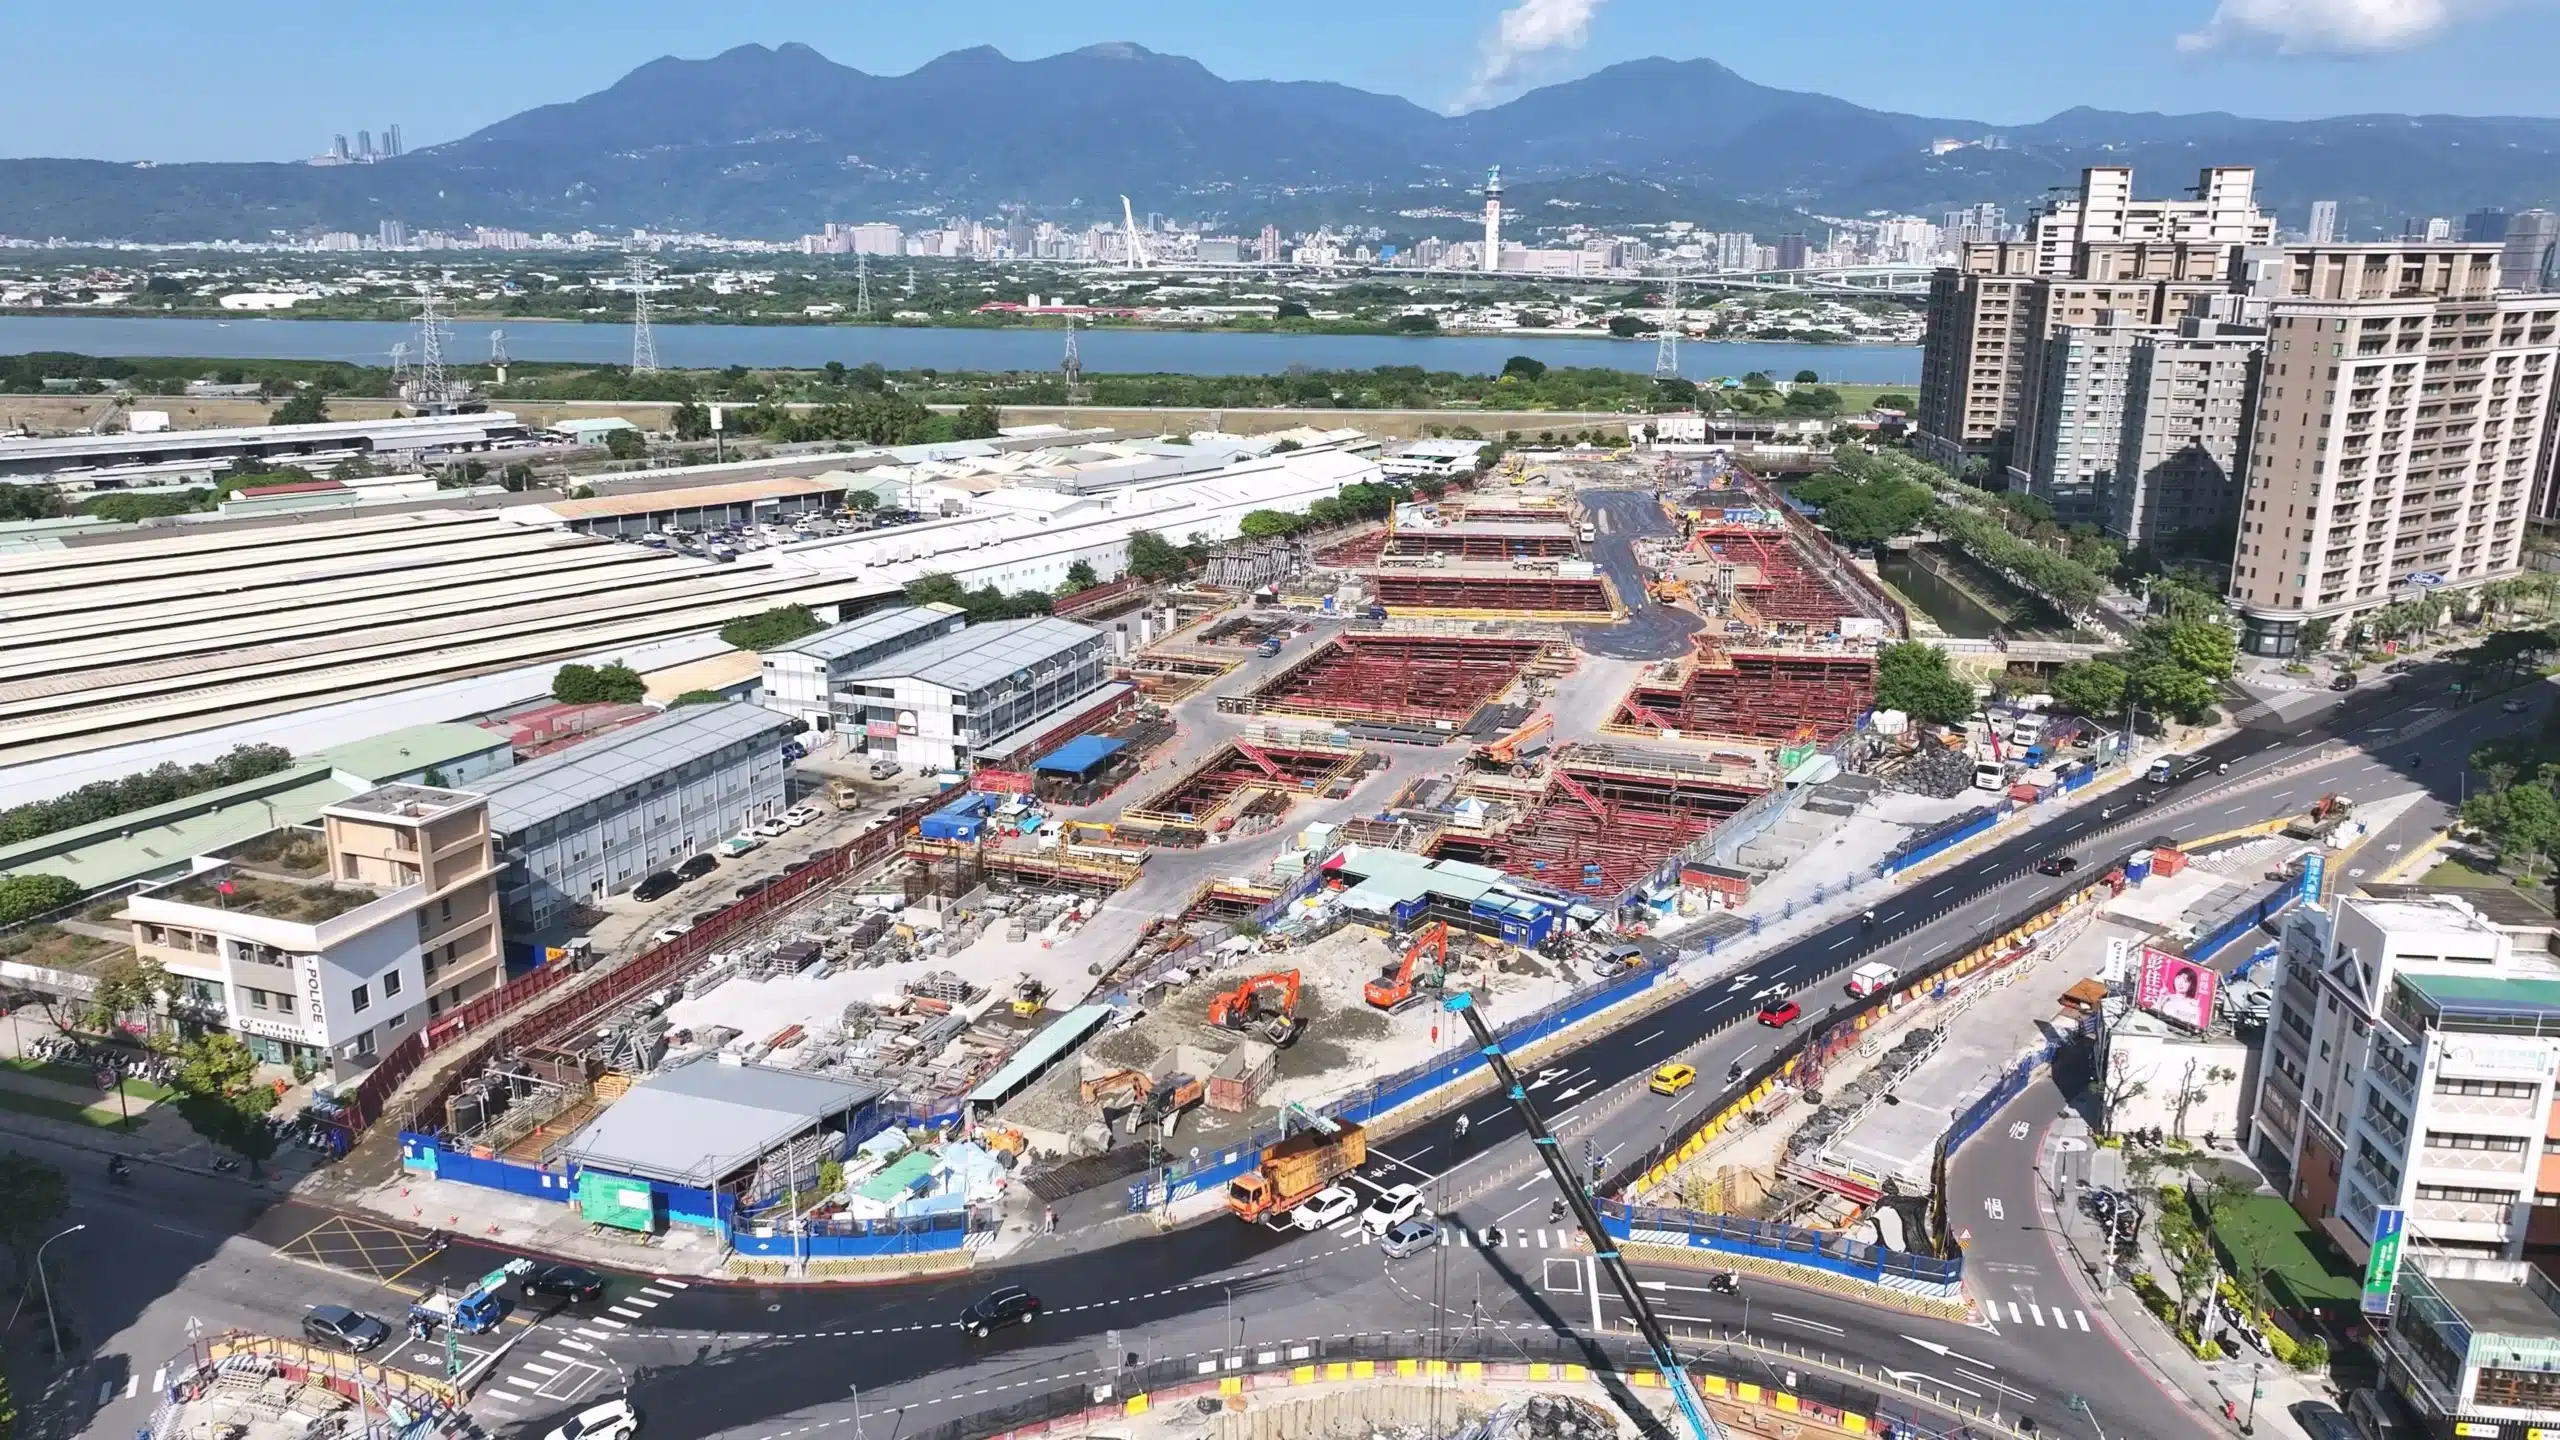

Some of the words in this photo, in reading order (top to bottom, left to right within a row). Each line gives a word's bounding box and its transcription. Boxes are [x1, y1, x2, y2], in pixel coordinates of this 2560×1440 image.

[306, 967, 324, 1024] POLICE
[2008, 1120, 2031, 1141] 慢
[1983, 1197, 2005, 1221] 慢
